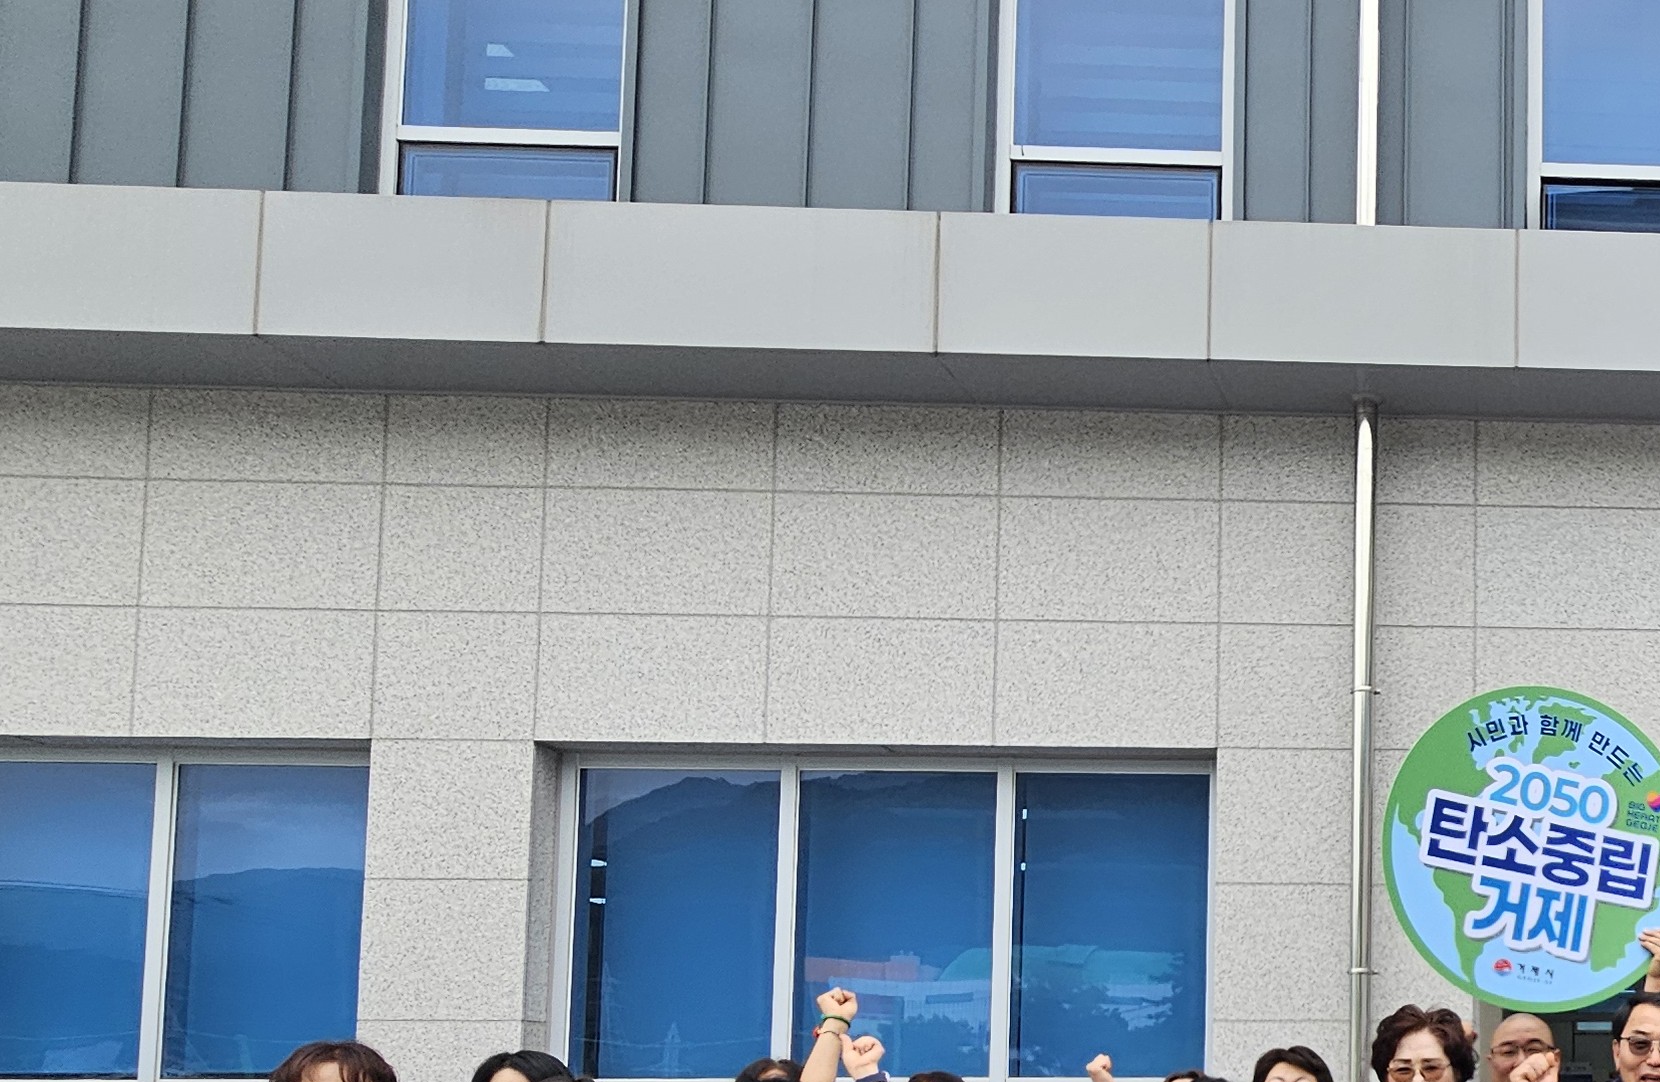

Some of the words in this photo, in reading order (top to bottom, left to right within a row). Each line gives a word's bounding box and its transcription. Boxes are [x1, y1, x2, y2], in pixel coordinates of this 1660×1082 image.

[1465, 715, 1529, 753] 시민과
[1540, 714, 1583, 743] 함께
[1588, 730, 1644, 787] 만드는
[1489, 763, 1610, 824] 2050
[1627, 810, 1660, 823] HEART
[1427, 797, 1652, 900] 탄소중립
[1472, 875, 1587, 953] 거제
